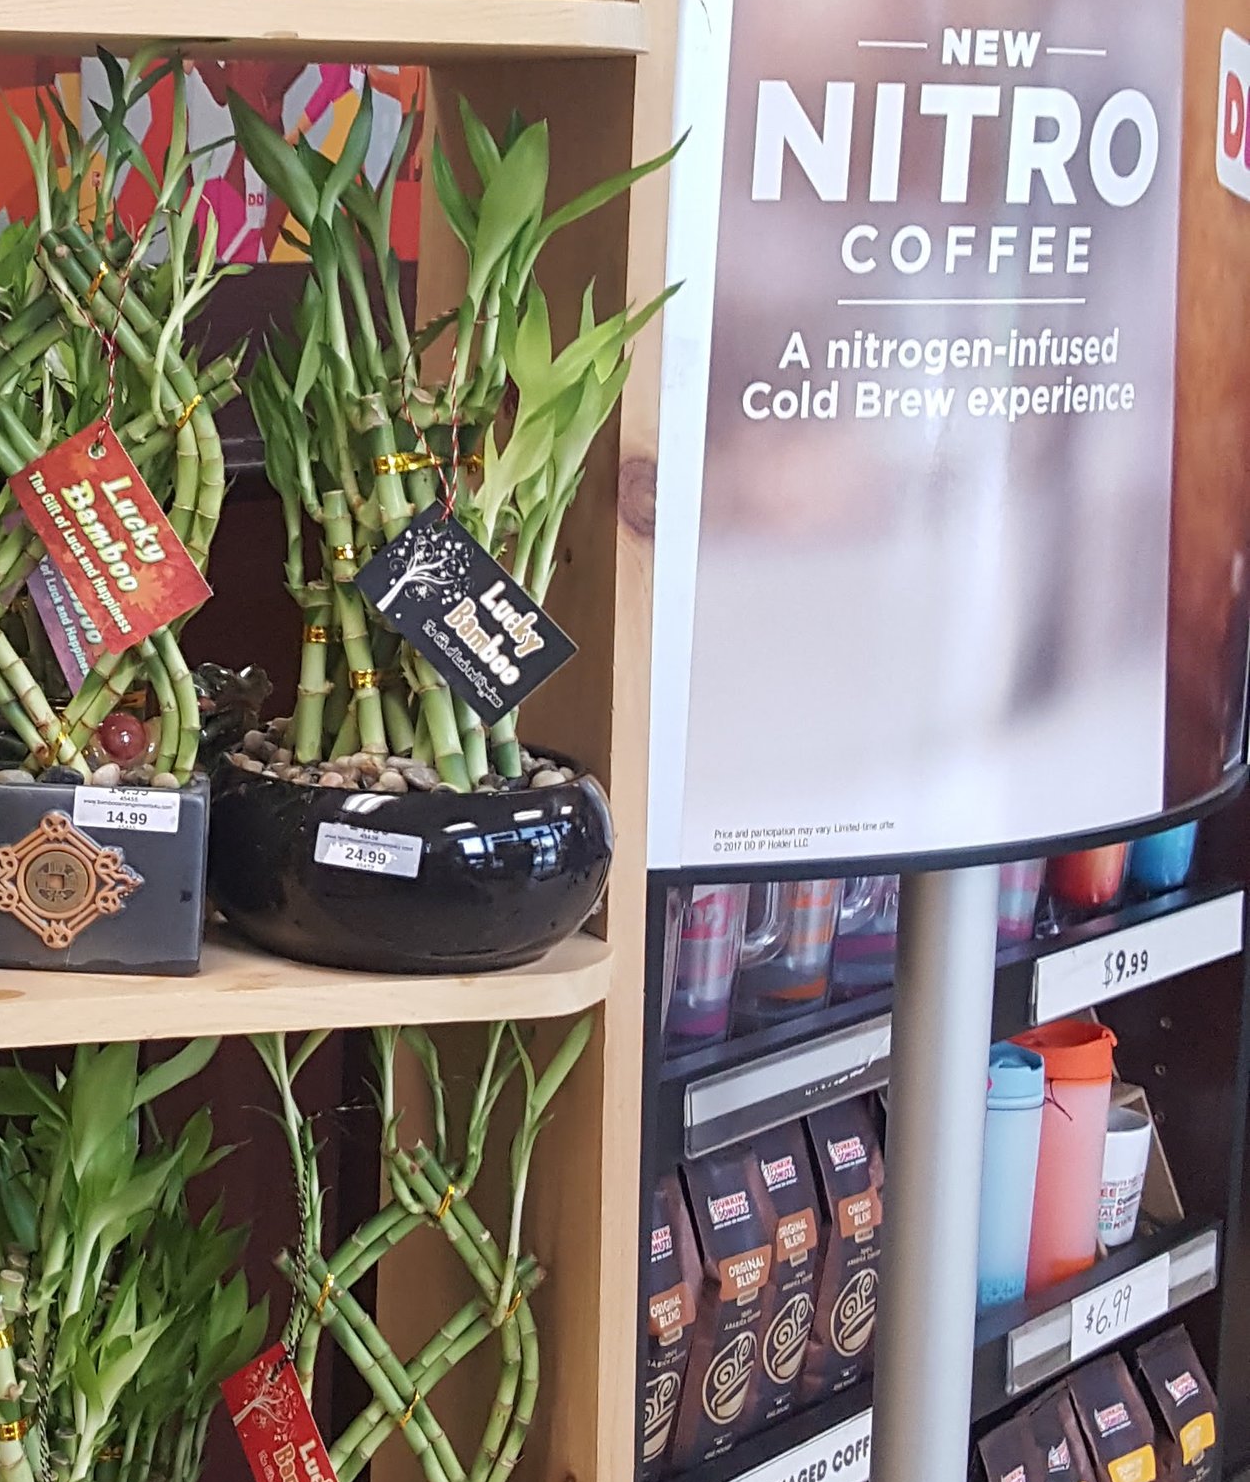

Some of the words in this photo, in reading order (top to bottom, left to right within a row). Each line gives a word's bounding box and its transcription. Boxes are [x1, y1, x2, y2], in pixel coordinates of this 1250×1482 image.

[941, 27, 1041, 68] NEW
[751, 80, 1159, 207] NITRO
[841, 225, 1091, 275] COFFEE
[779, 332, 810, 369] A
[827, 327, 1119, 375] nitrogen-infused
[742, 380, 839, 419] Cold
[855, 381, 955, 418] Brew
[967, 376, 1135, 422] experience
[29, 471, 46, 495] The
[42, 493, 62, 518] Gift
[54, 515, 71, 529] of
[101, 476, 166, 563] Lucky
[61, 478, 139, 593] Bamboo
[62, 527, 86, 557] Luck
[78, 554, 100, 578] and
[46, 577, 62, 605] Luck
[56, 601, 72, 624] and
[91, 575, 132, 634] Happiness
[480, 580, 544, 658] Lucky
[444, 597, 520, 685] Bamboo
[106, 810, 148, 825] 14.99
[714, 829, 732, 839] Price
[735, 828, 748, 838] and
[751, 828, 795, 838] participation
[798, 826, 813, 837] may
[834, 821, 860, 833] Limited
[862, 821, 877, 831] time
[879, 820, 895, 830] offer
[345, 847, 386, 865] 24.99
[724, 841, 741, 851] 2017
[758, 840, 766, 850] IP
[768, 839, 791, 849] Holder
[794, 838, 808, 847] LLC
[1101, 949, 1149, 987] $9.99
[784, 1231, 806, 1249] BLEND
[728, 1256, 765, 1278] ORIGINAL
[737, 1270, 760, 1288] BLEND
[651, 1294, 682, 1318] ORIGINAL
[659, 1310, 681, 1329] BLEND
[1083, 1284, 1132, 1335] $6.99
[831, 1435, 870, 1473] COFF
